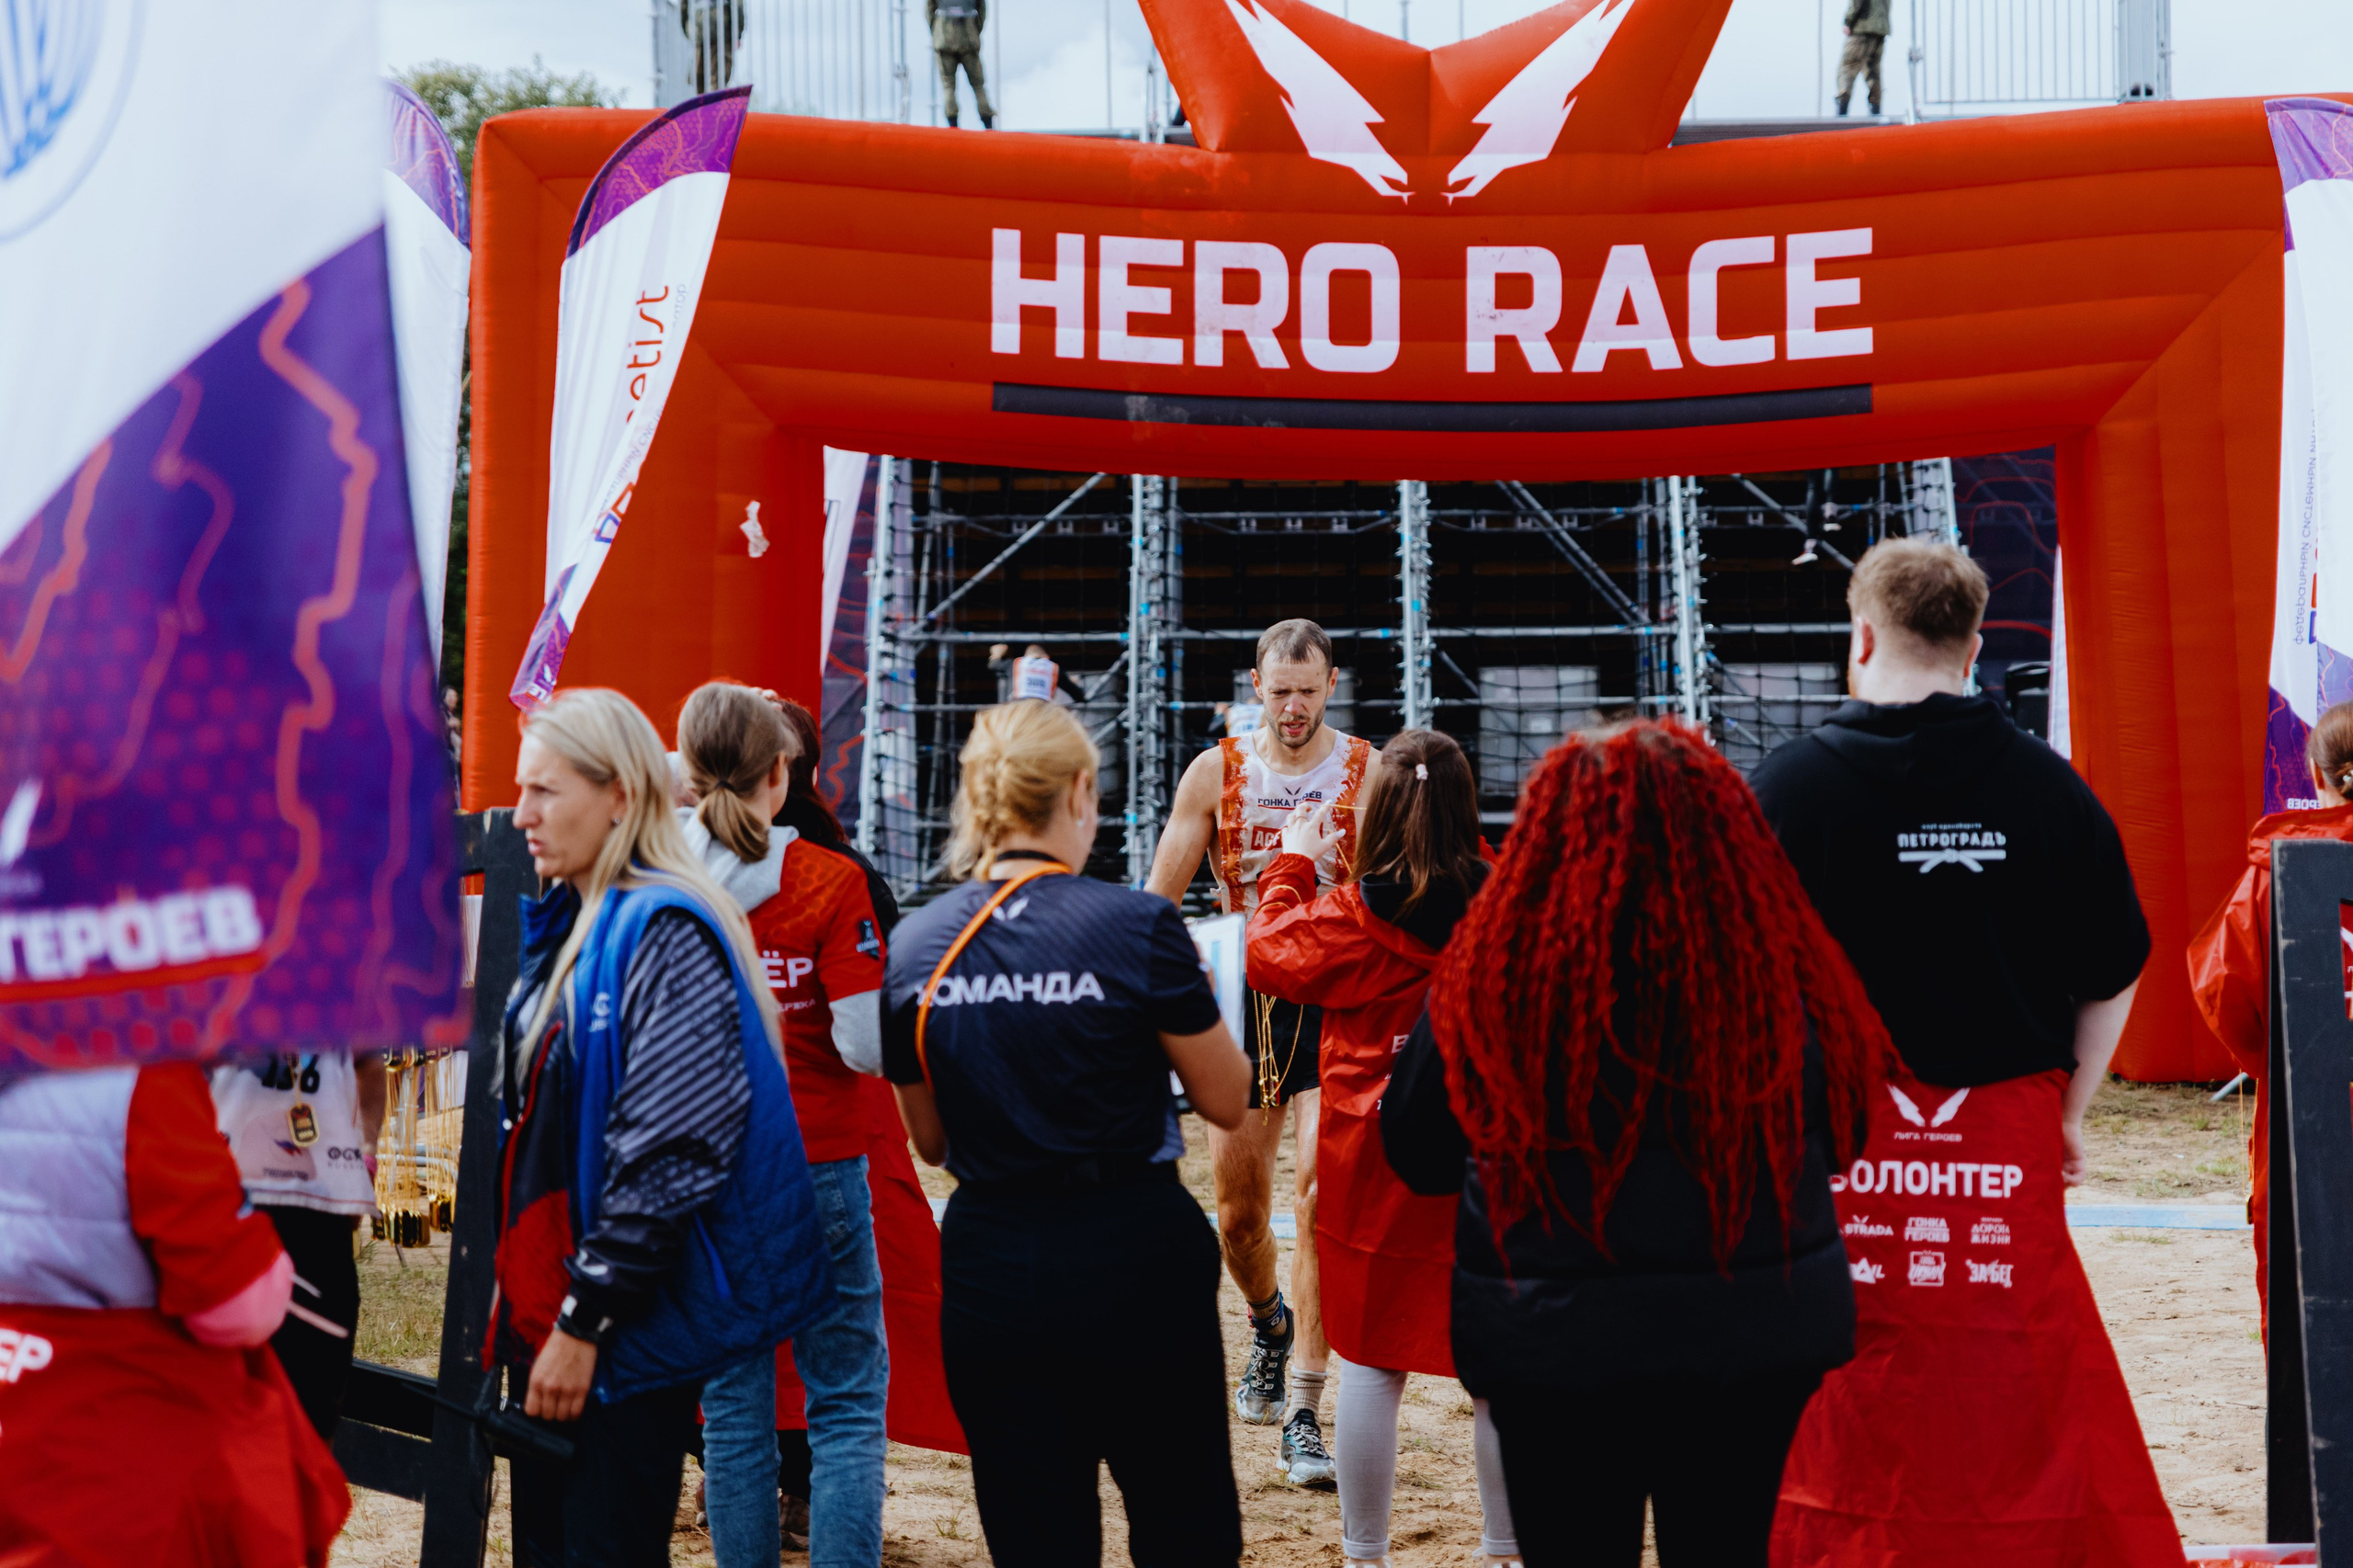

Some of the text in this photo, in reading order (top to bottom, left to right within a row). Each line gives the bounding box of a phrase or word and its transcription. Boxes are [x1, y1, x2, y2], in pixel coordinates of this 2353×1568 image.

[991, 227, 1874, 373] HERO RACE
[1897, 831, 2006, 847] ПЕТРОГРАДЪ
